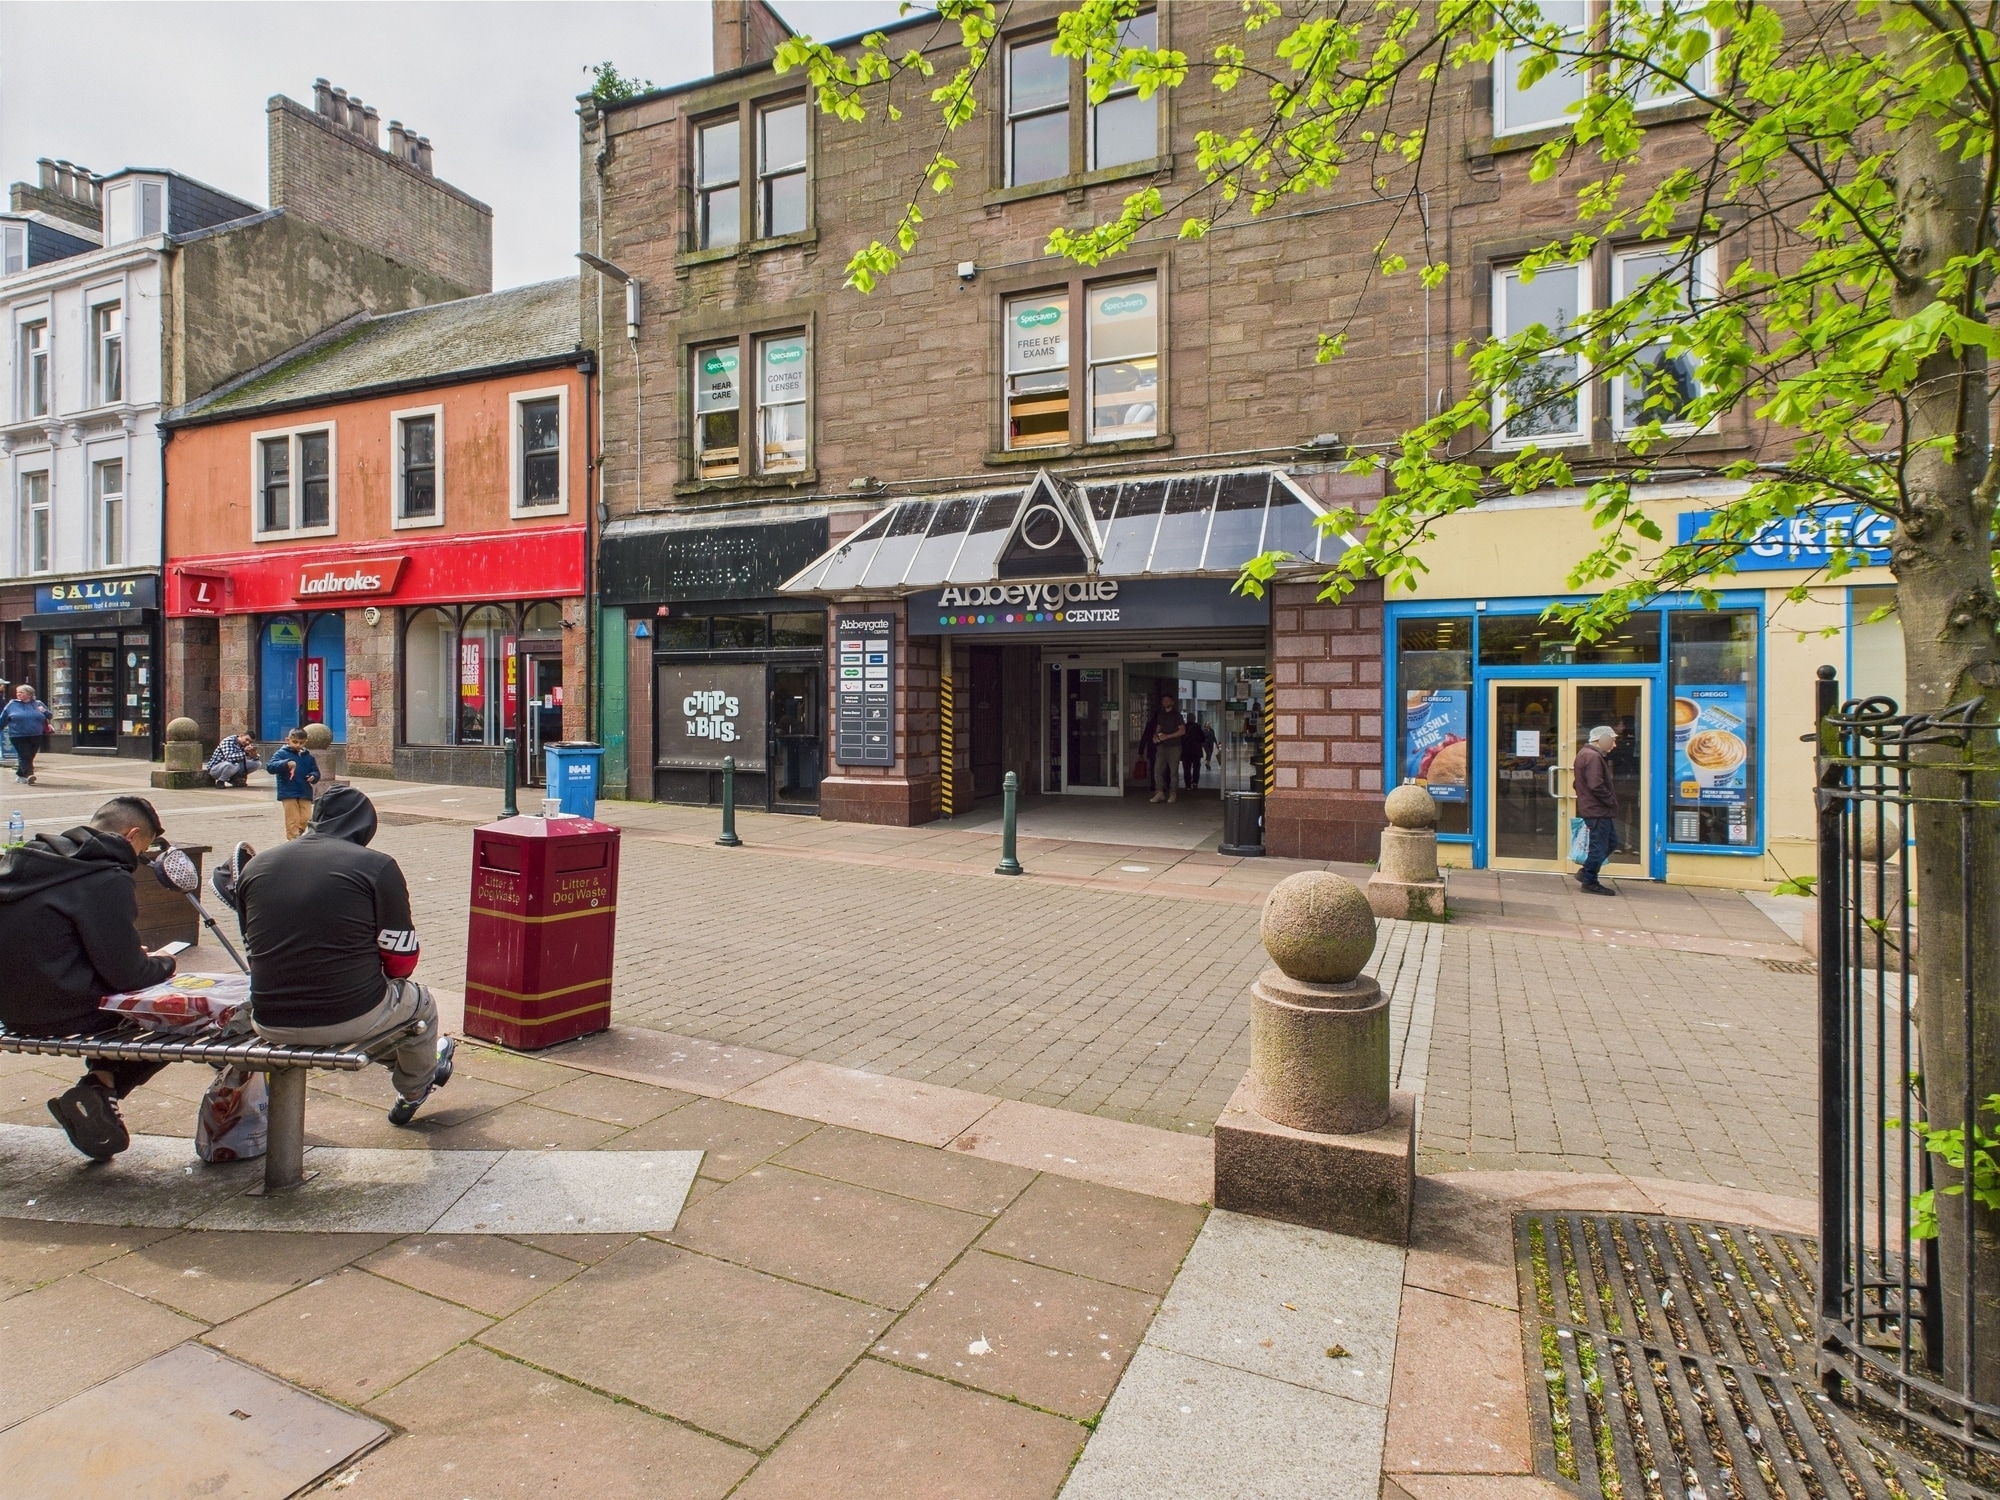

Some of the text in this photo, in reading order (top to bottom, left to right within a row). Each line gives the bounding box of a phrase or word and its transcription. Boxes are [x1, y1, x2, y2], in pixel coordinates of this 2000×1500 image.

[1105, 299, 1143, 311] Specsavers
[1020, 311, 1057, 324] Specsavers
[1018, 336, 1060, 348] FREE EYE
[770, 349, 800, 361] Specsavers
[1024, 347, 1055, 358] EXAMS
[708, 360, 736, 370] Specsavers
[768, 372, 802, 382] CONTACT
[712, 382, 731, 390] HEAR
[771, 382, 800, 392] LENSES
[712, 391, 731, 400] CARE
[1750, 515, 1894, 557] GREG
[300, 570, 380, 594] Ladbrokes
[52, 580, 136, 600] SALUT
[197, 582, 210, 602] L
[938, 581, 1119, 611] Abbeygate
[1066, 609, 1120, 623] CENTRE
[840, 619, 889, 631] Abbeygate
[308, 663, 318, 682] IG
[686, 720, 696, 736] N
[1410, 713, 1450, 740] FRESHLY
[1414, 729, 1442, 750] MADE
[485, 875, 514, 890] Litter &
[562, 876, 599, 890] Litter &
[478, 886, 520, 904] Dog Waste
[553, 887, 607, 904] Dog Waste
[378, 929, 417, 951] SU
